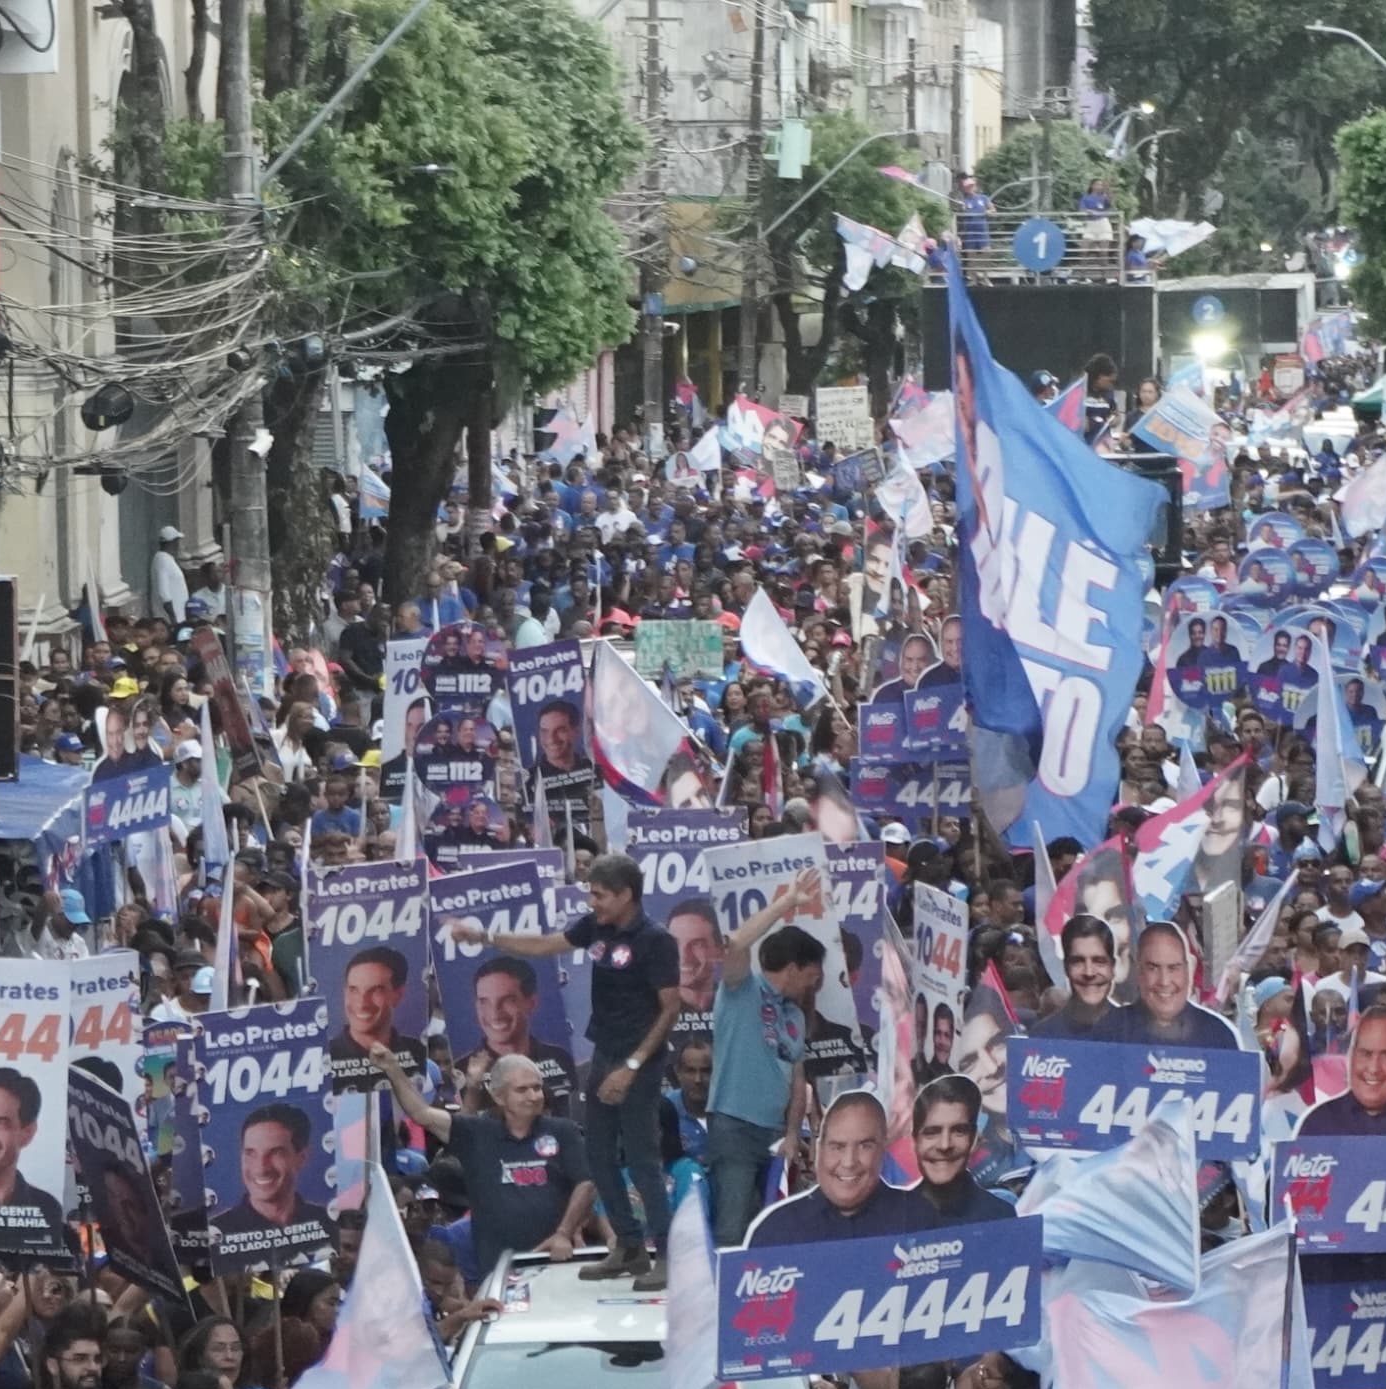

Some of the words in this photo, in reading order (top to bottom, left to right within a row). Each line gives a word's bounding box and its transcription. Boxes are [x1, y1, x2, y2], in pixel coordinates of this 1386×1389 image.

[1033, 231, 1045, 260] 1
[512, 664, 584, 705] 1044
[642, 851, 712, 895] 104
[316, 895, 422, 947] 1044
[916, 922, 962, 979] 1044
[206, 1046, 325, 1105] 1044
[1021, 1054, 1072, 1079] Neto
[1283, 1153, 1339, 1178] Neto
[219, 1244, 239, 1255] DO
[239, 1239, 272, 1254] LADO
[273, 1237, 290, 1249] DA
[225, 1231, 264, 1245] PERTO
[265, 1228, 282, 1240] DA
[893, 1239, 964, 1265] SANDRO
[735, 1265, 805, 1298] Neto
[814, 1264, 1031, 1351] 44444
